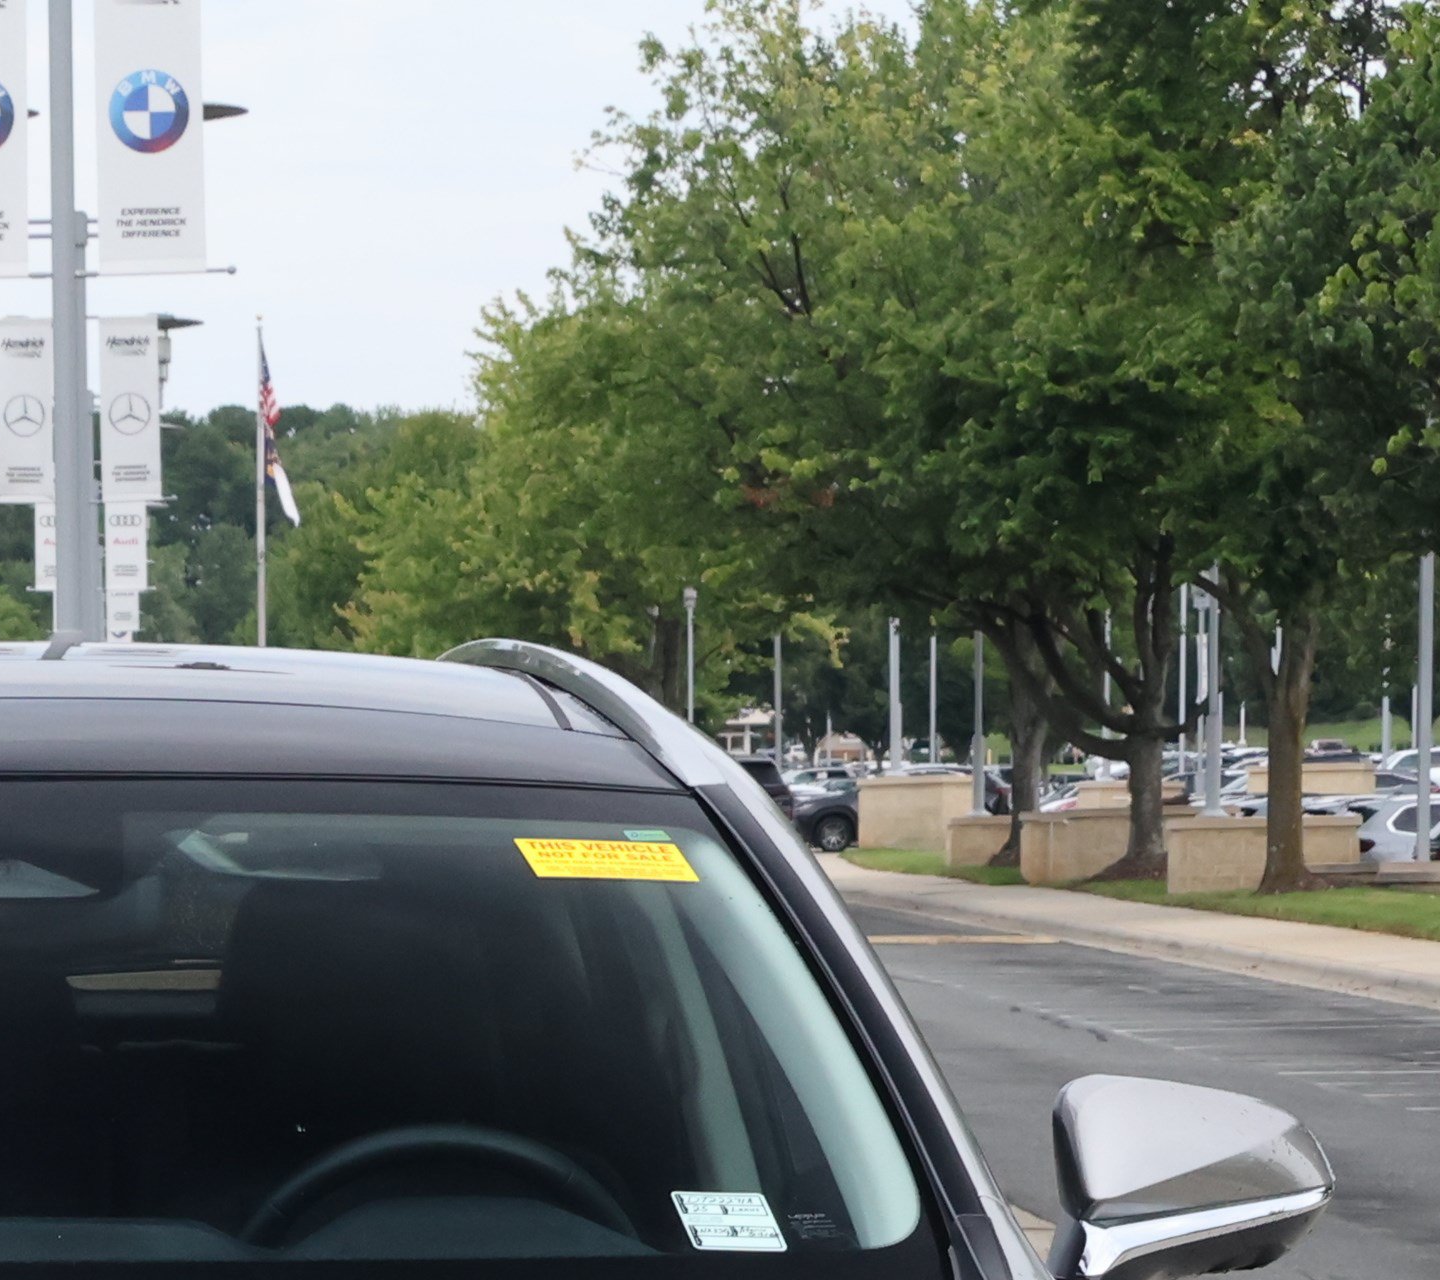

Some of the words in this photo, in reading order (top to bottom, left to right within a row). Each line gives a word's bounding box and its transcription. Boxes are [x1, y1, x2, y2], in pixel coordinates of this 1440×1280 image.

[117, 70, 181, 96] BMW
[121, 207, 180, 216] EXPERIENCE
[117, 219, 133, 227] THE
[136, 218, 186, 226] HENDRICK
[122, 230, 180, 238] DIFFERENCE
[526, 841, 576, 851] THIS
[581, 843, 673, 854] VEHICLE
[538, 851, 575, 859] NOT
[582, 852, 620, 860] FOR
[626, 853, 676, 862] SALE
